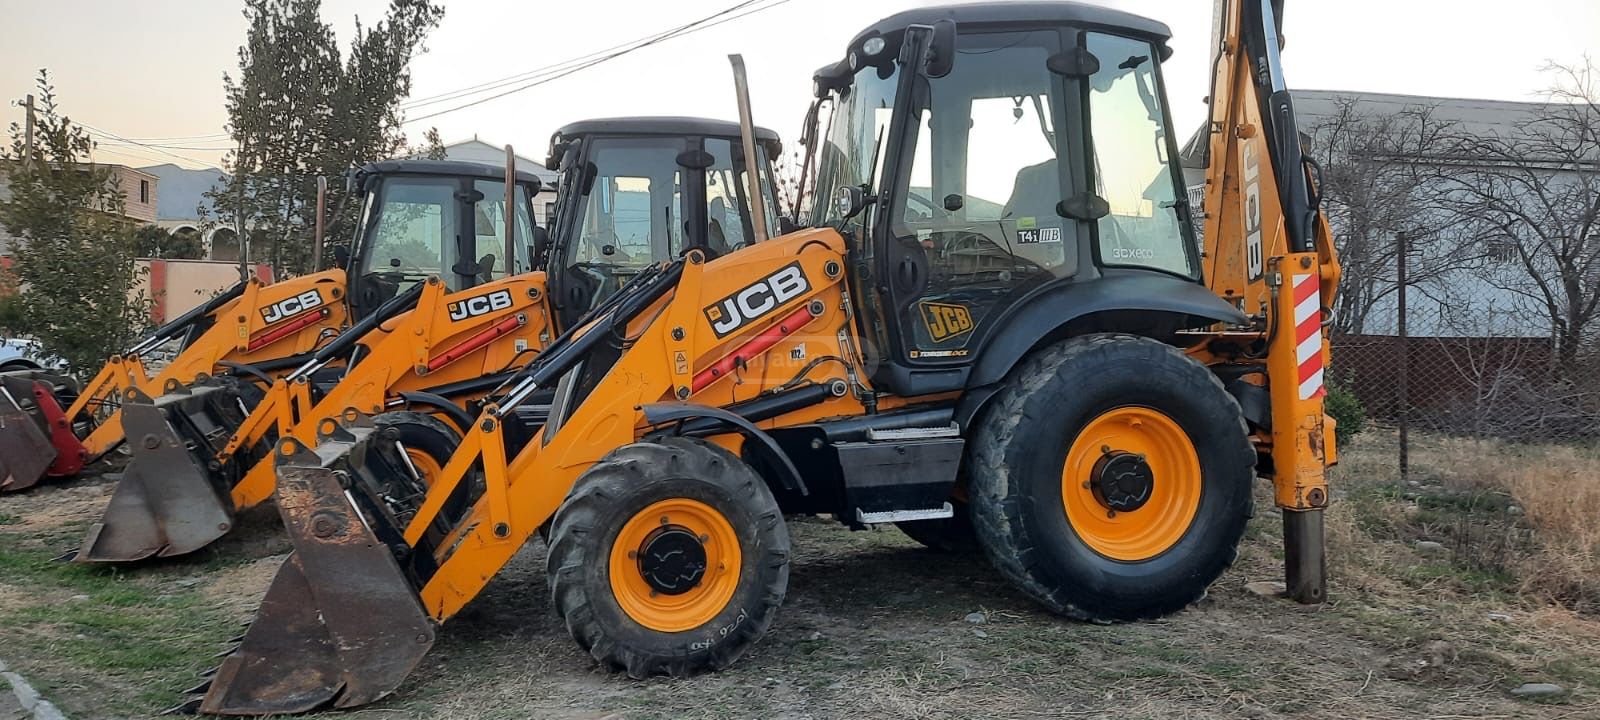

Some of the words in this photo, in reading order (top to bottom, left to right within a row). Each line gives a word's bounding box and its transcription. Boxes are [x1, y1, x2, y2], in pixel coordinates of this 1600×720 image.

[1243, 143, 1263, 281] JCB
[1018, 230, 1039, 243] T4i
[264, 290, 322, 323] JCB
[451, 290, 512, 320] JCB
[713, 266, 808, 334] JCB
[928, 305, 970, 338] JCB
